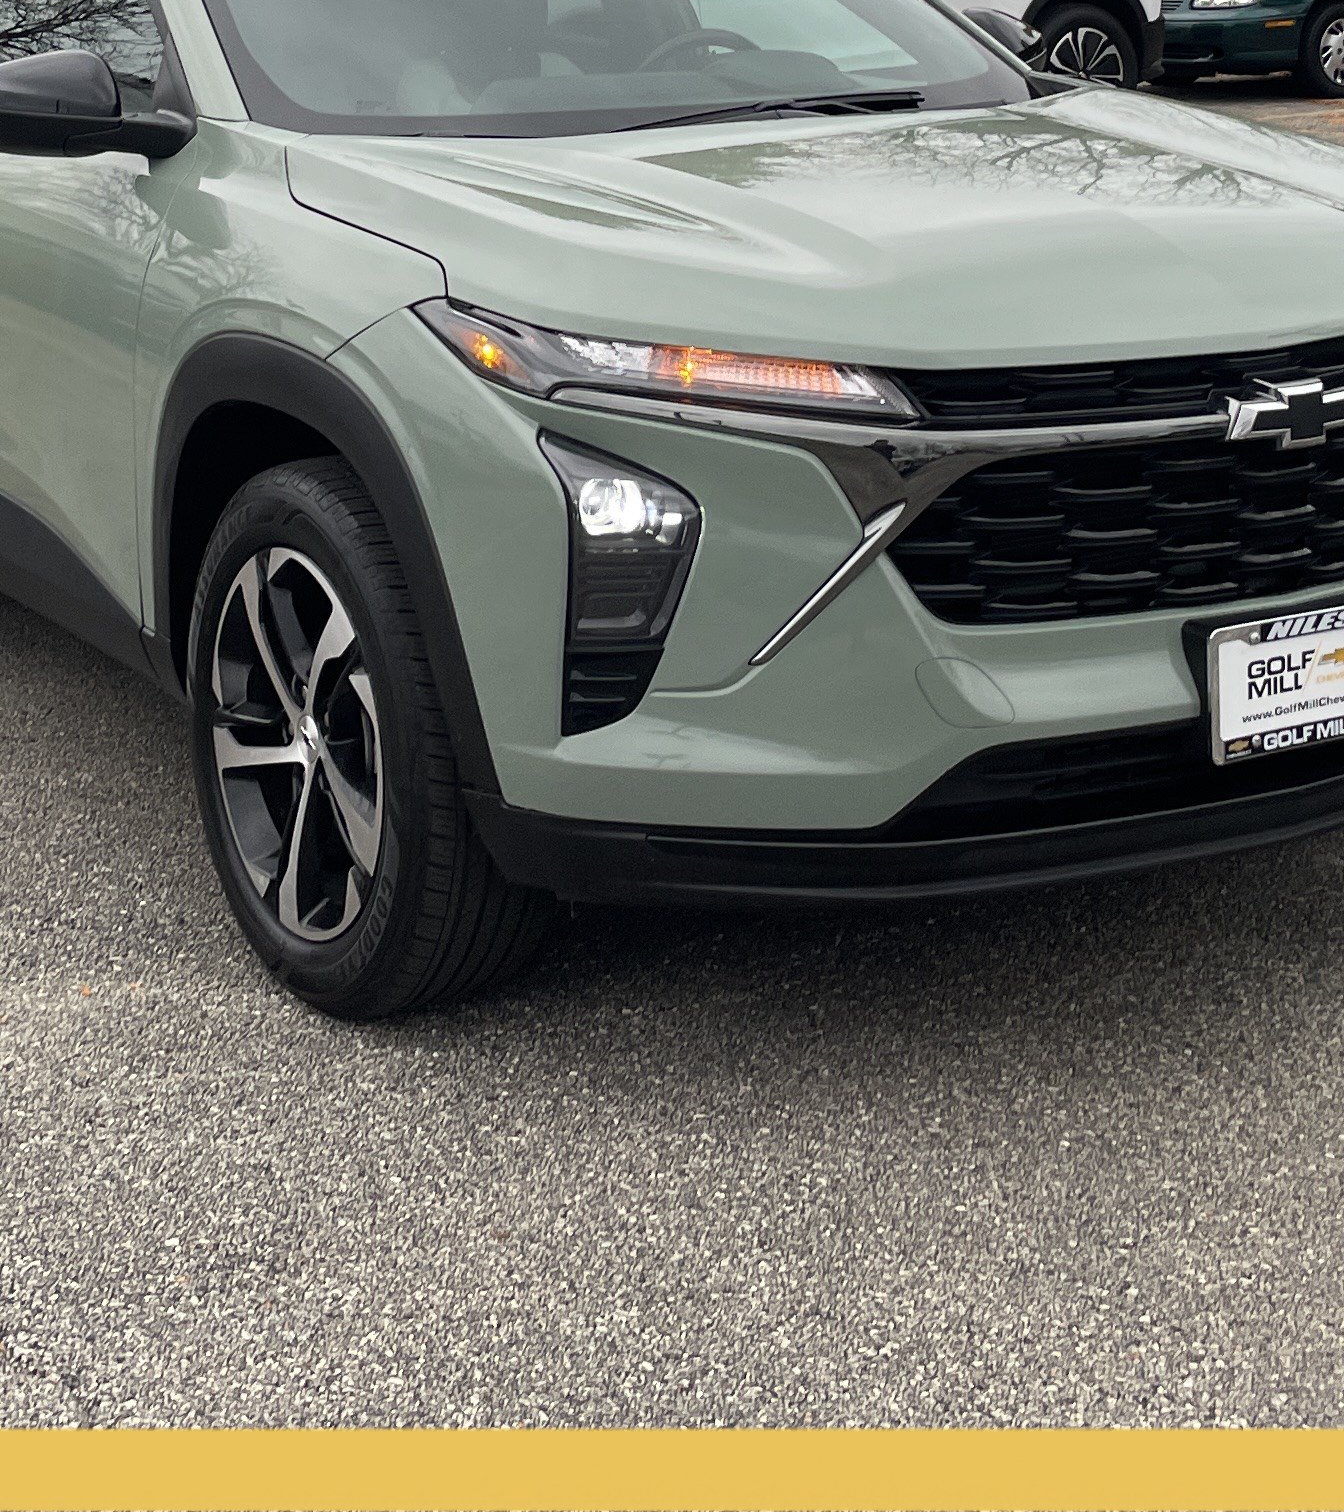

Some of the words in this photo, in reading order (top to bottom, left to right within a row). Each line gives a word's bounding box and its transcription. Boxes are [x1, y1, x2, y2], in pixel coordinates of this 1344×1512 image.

[1247, 648, 1316, 679] GOLF
[1247, 672, 1303, 700] MILL
[1263, 725, 1315, 751] GOLF
